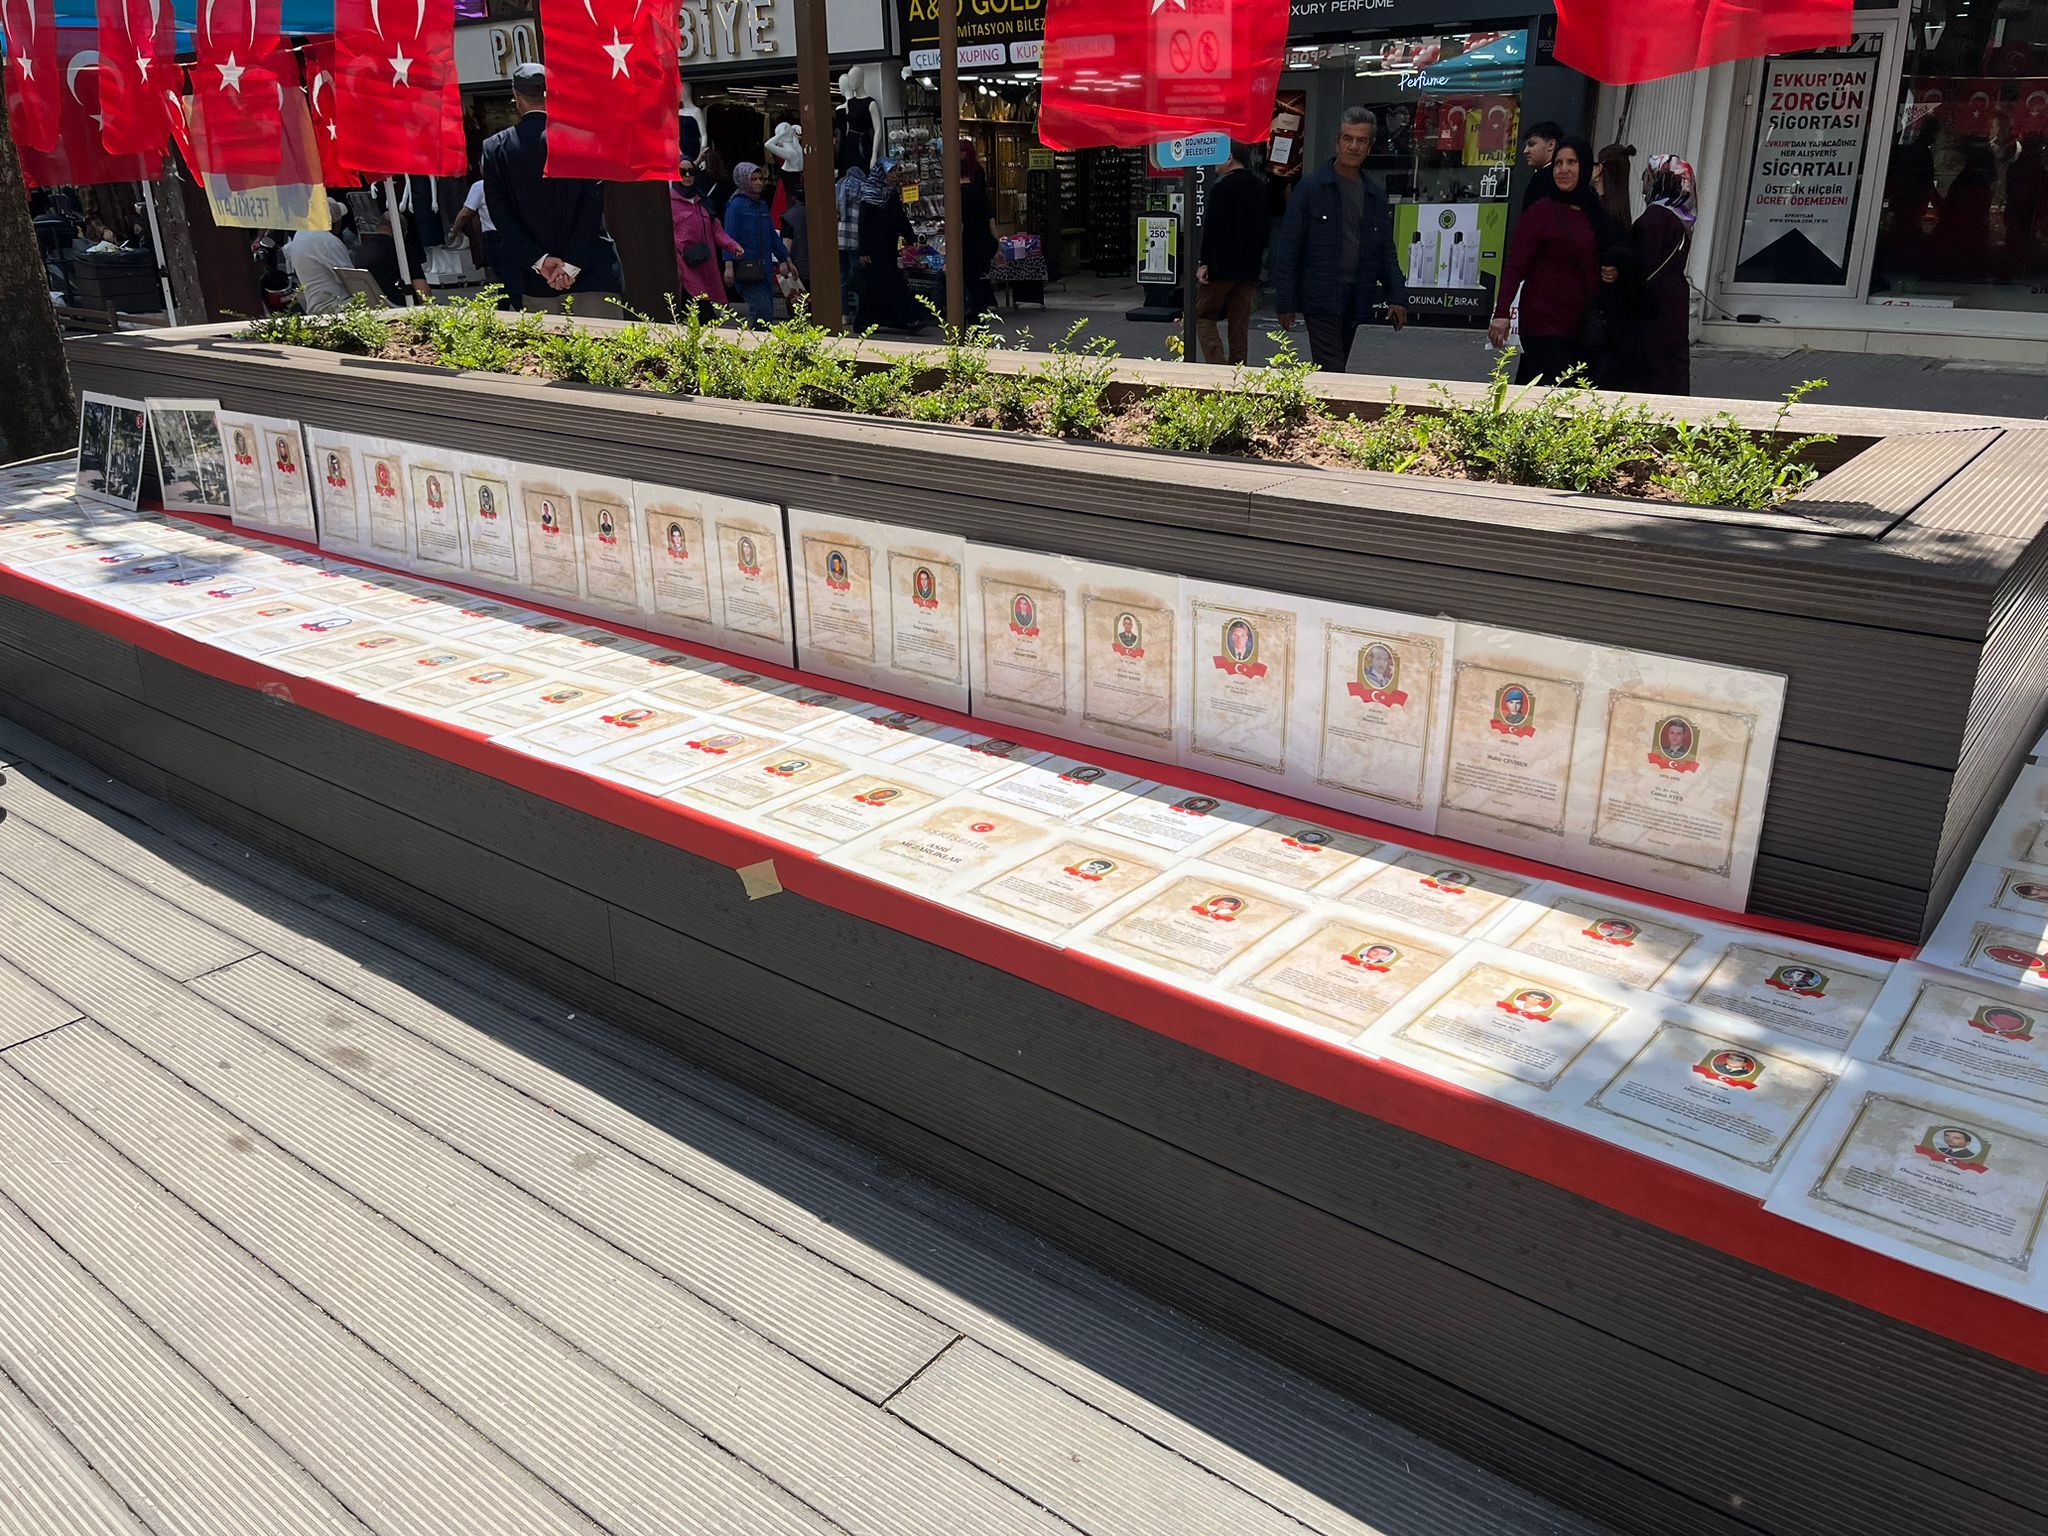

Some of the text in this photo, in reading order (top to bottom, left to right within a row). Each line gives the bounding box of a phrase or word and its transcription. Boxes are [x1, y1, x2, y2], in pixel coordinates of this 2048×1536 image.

[1331, 0, 1395, 13] PERFUME
[1398, 71, 1449, 91] Perfume
[1773, 71, 1867, 87] EVKUR'DAN
[1770, 86, 1864, 111] ZORGÜN
[1185, 137, 1219, 146] ODUNPAZARI
[1808, 138, 1857, 148] YAPACAĞINIZ
[1780, 149, 1838, 158] HER ALIŞVERİŞ
[1761, 158, 1853, 177] SİGORTALI
[1765, 183, 1843, 196] ÜSTELİK HİÇBİR
[1756, 193, 1849, 206] ÜCRET ÖDEMEDEN!
[1149, 230, 1166, 238] 250
[1408, 295, 1443, 305] OKUNLA
[1454, 298, 1479, 307] BIRAK
